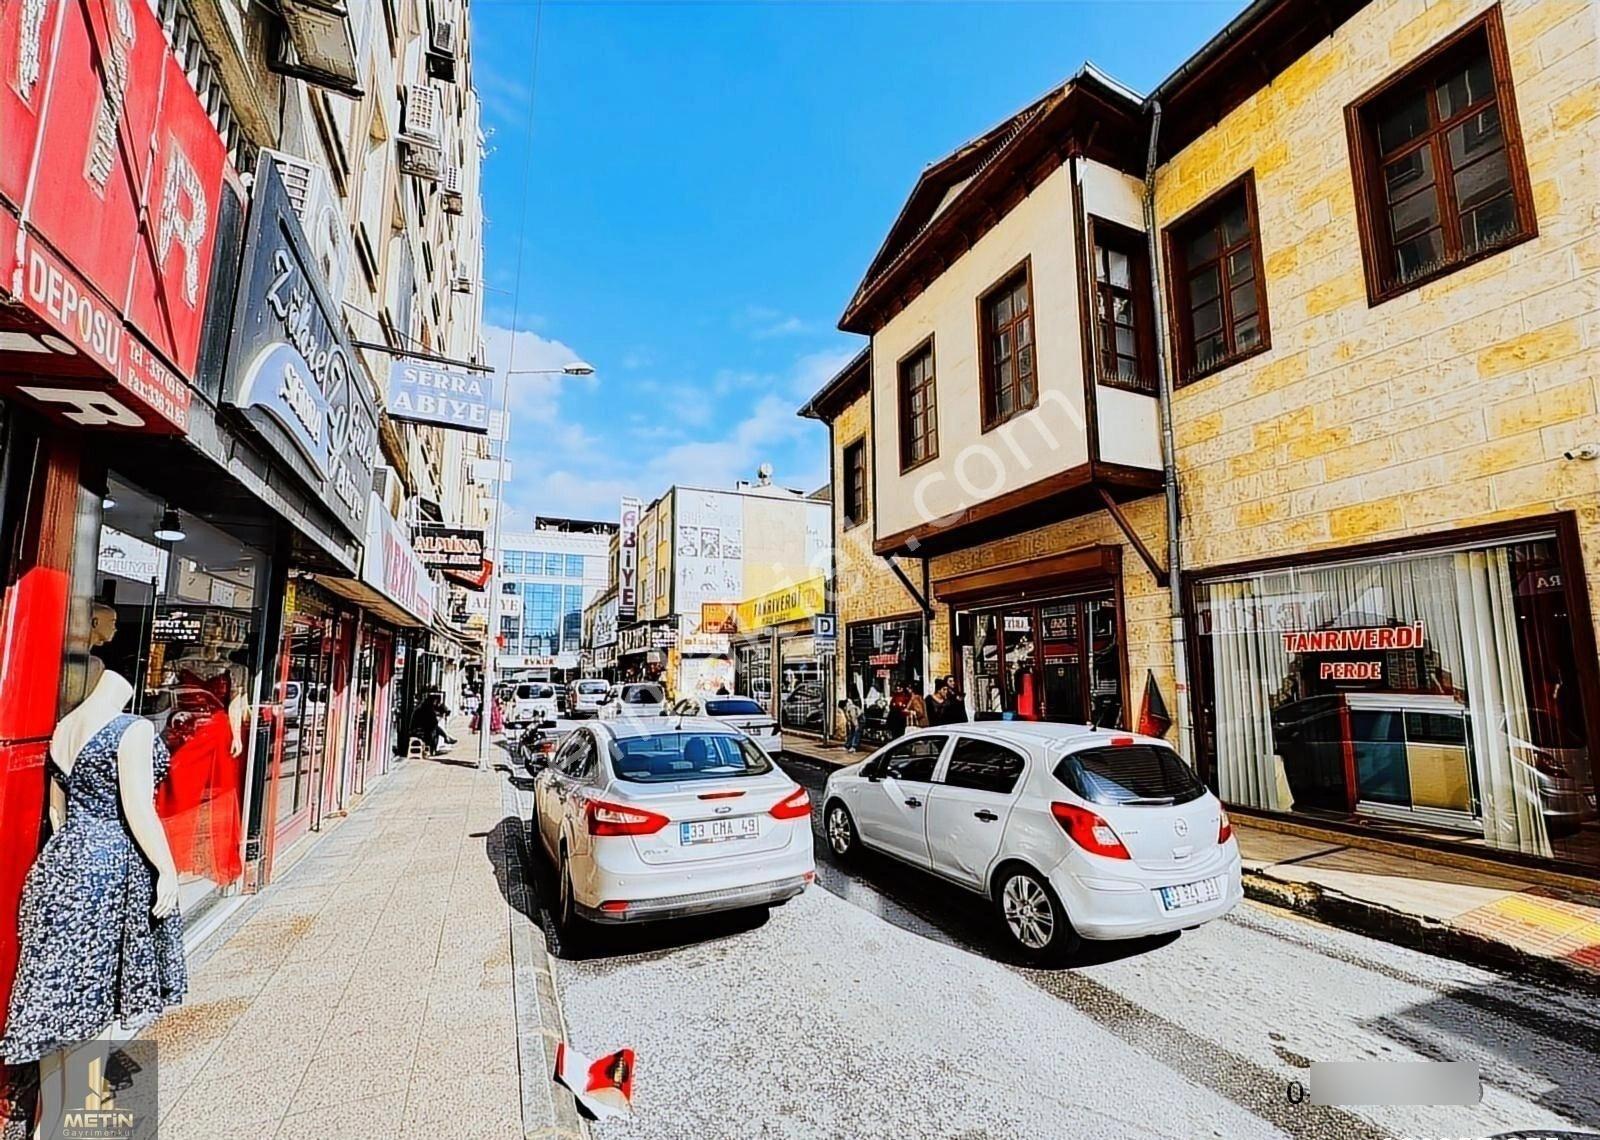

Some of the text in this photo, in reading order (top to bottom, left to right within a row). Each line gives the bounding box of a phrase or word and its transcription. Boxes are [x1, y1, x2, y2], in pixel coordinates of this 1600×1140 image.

[29, 249, 120, 365] DEPOSU
[403, 368, 484, 396] SERRA
[392, 391, 486, 423] ABİYE
[413, 535, 482, 553] ALMİNA
[820, 620, 831, 633] D
[1281, 619, 1424, 652] TANRIVERDİ
[1320, 662, 1382, 679] PERDE
[691, 824, 705, 838] 33
[742, 818, 755, 833] 49
